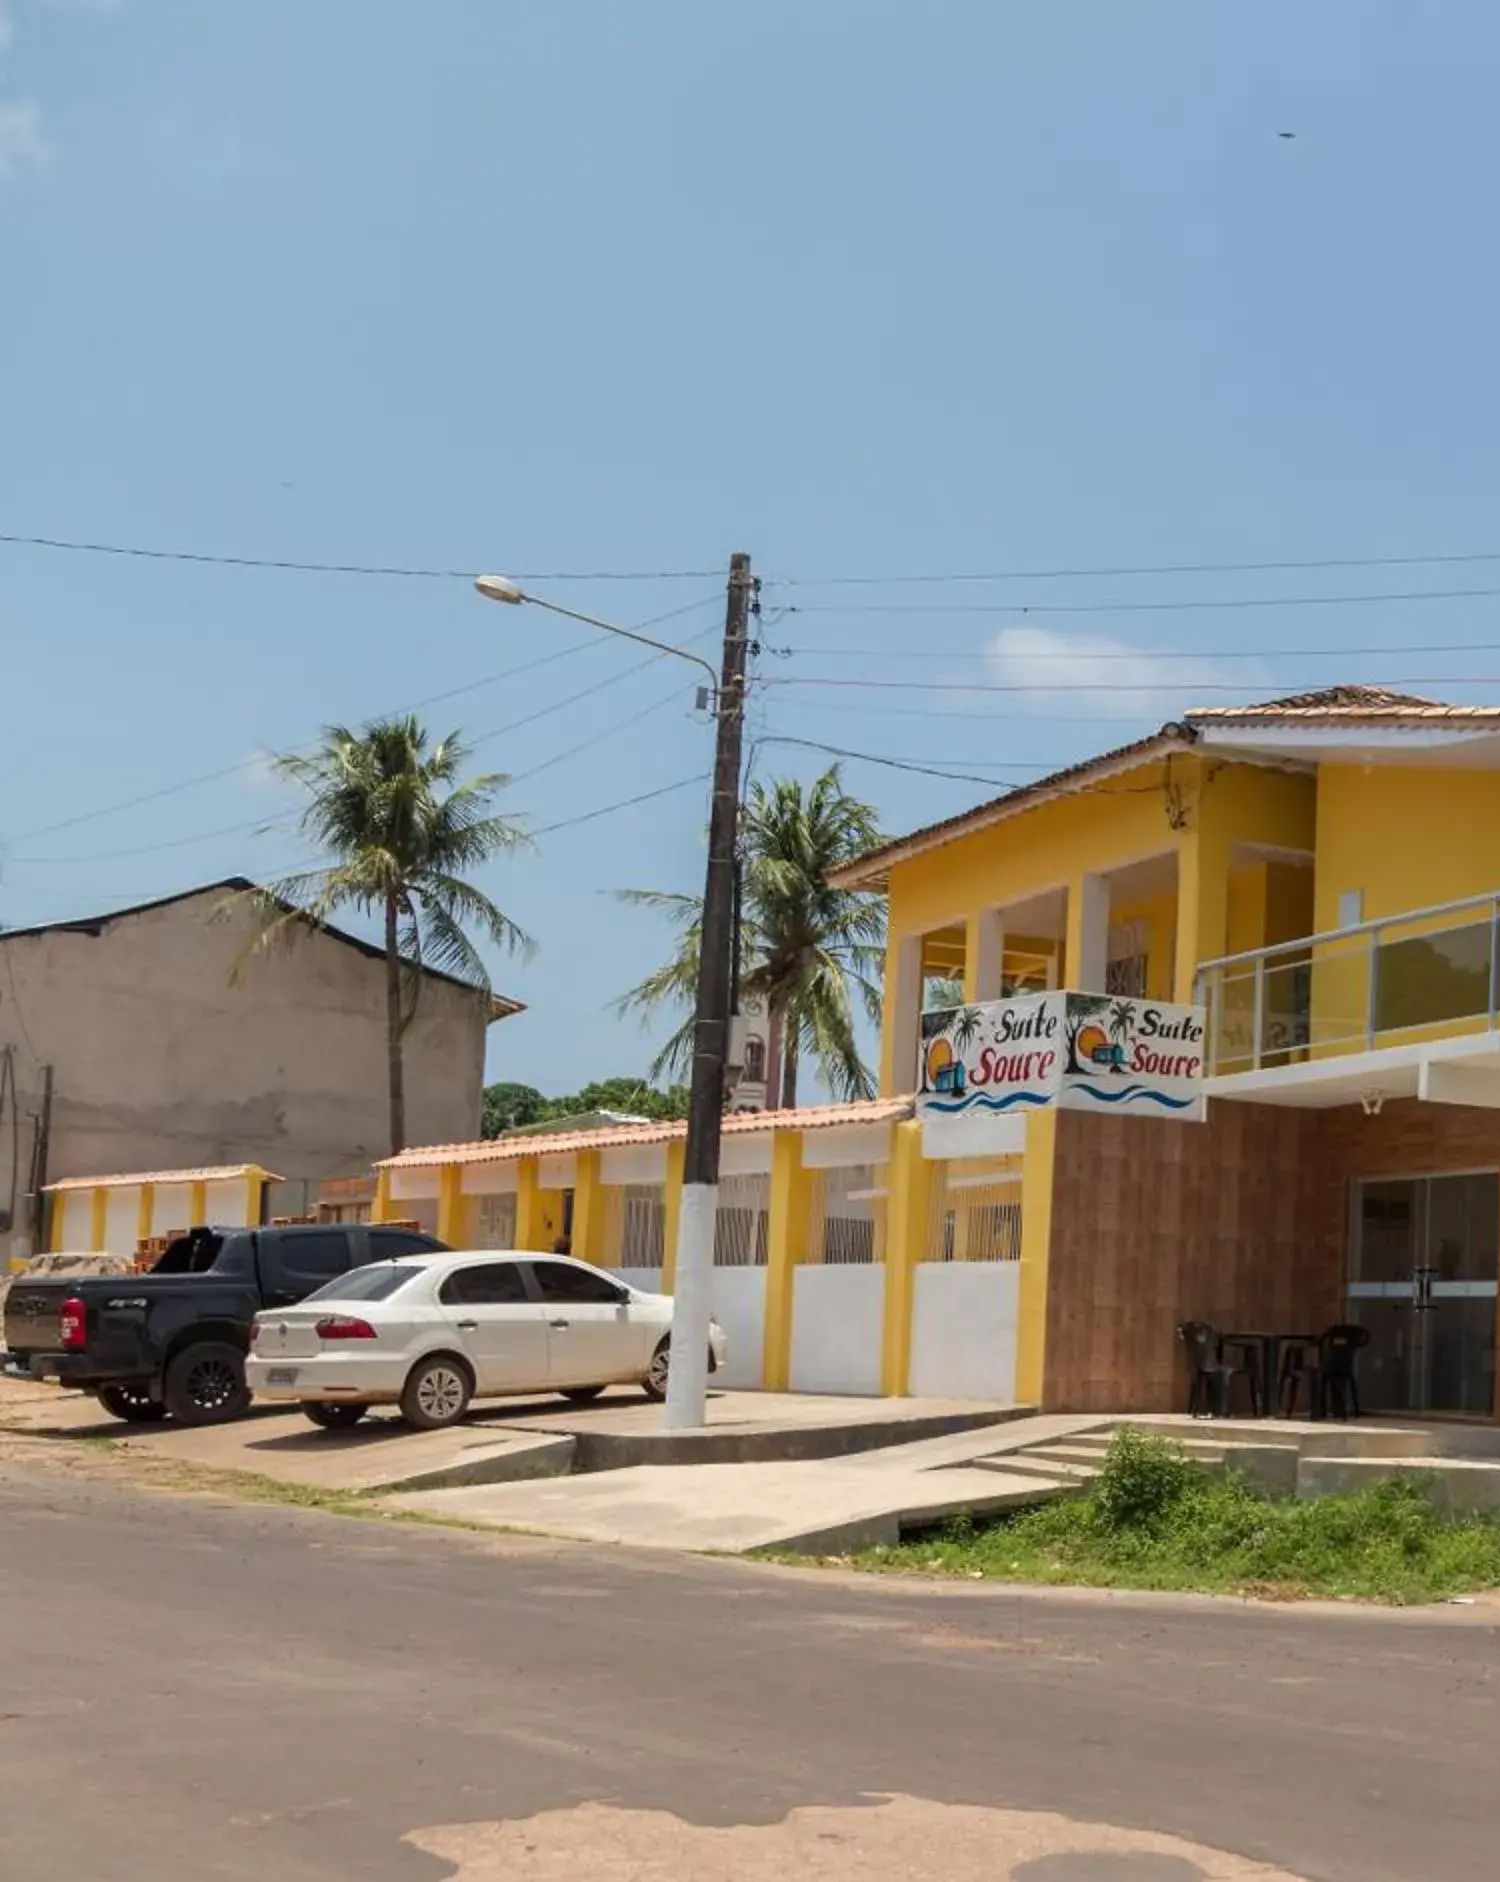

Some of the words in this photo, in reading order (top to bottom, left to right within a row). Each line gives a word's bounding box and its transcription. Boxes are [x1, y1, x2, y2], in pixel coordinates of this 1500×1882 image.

[994, 1001, 1057, 1043] Suite
[1138, 1009, 1202, 1042] Suite
[969, 1047, 1055, 1086] Soure
[1131, 1043, 1200, 1078] Soure
